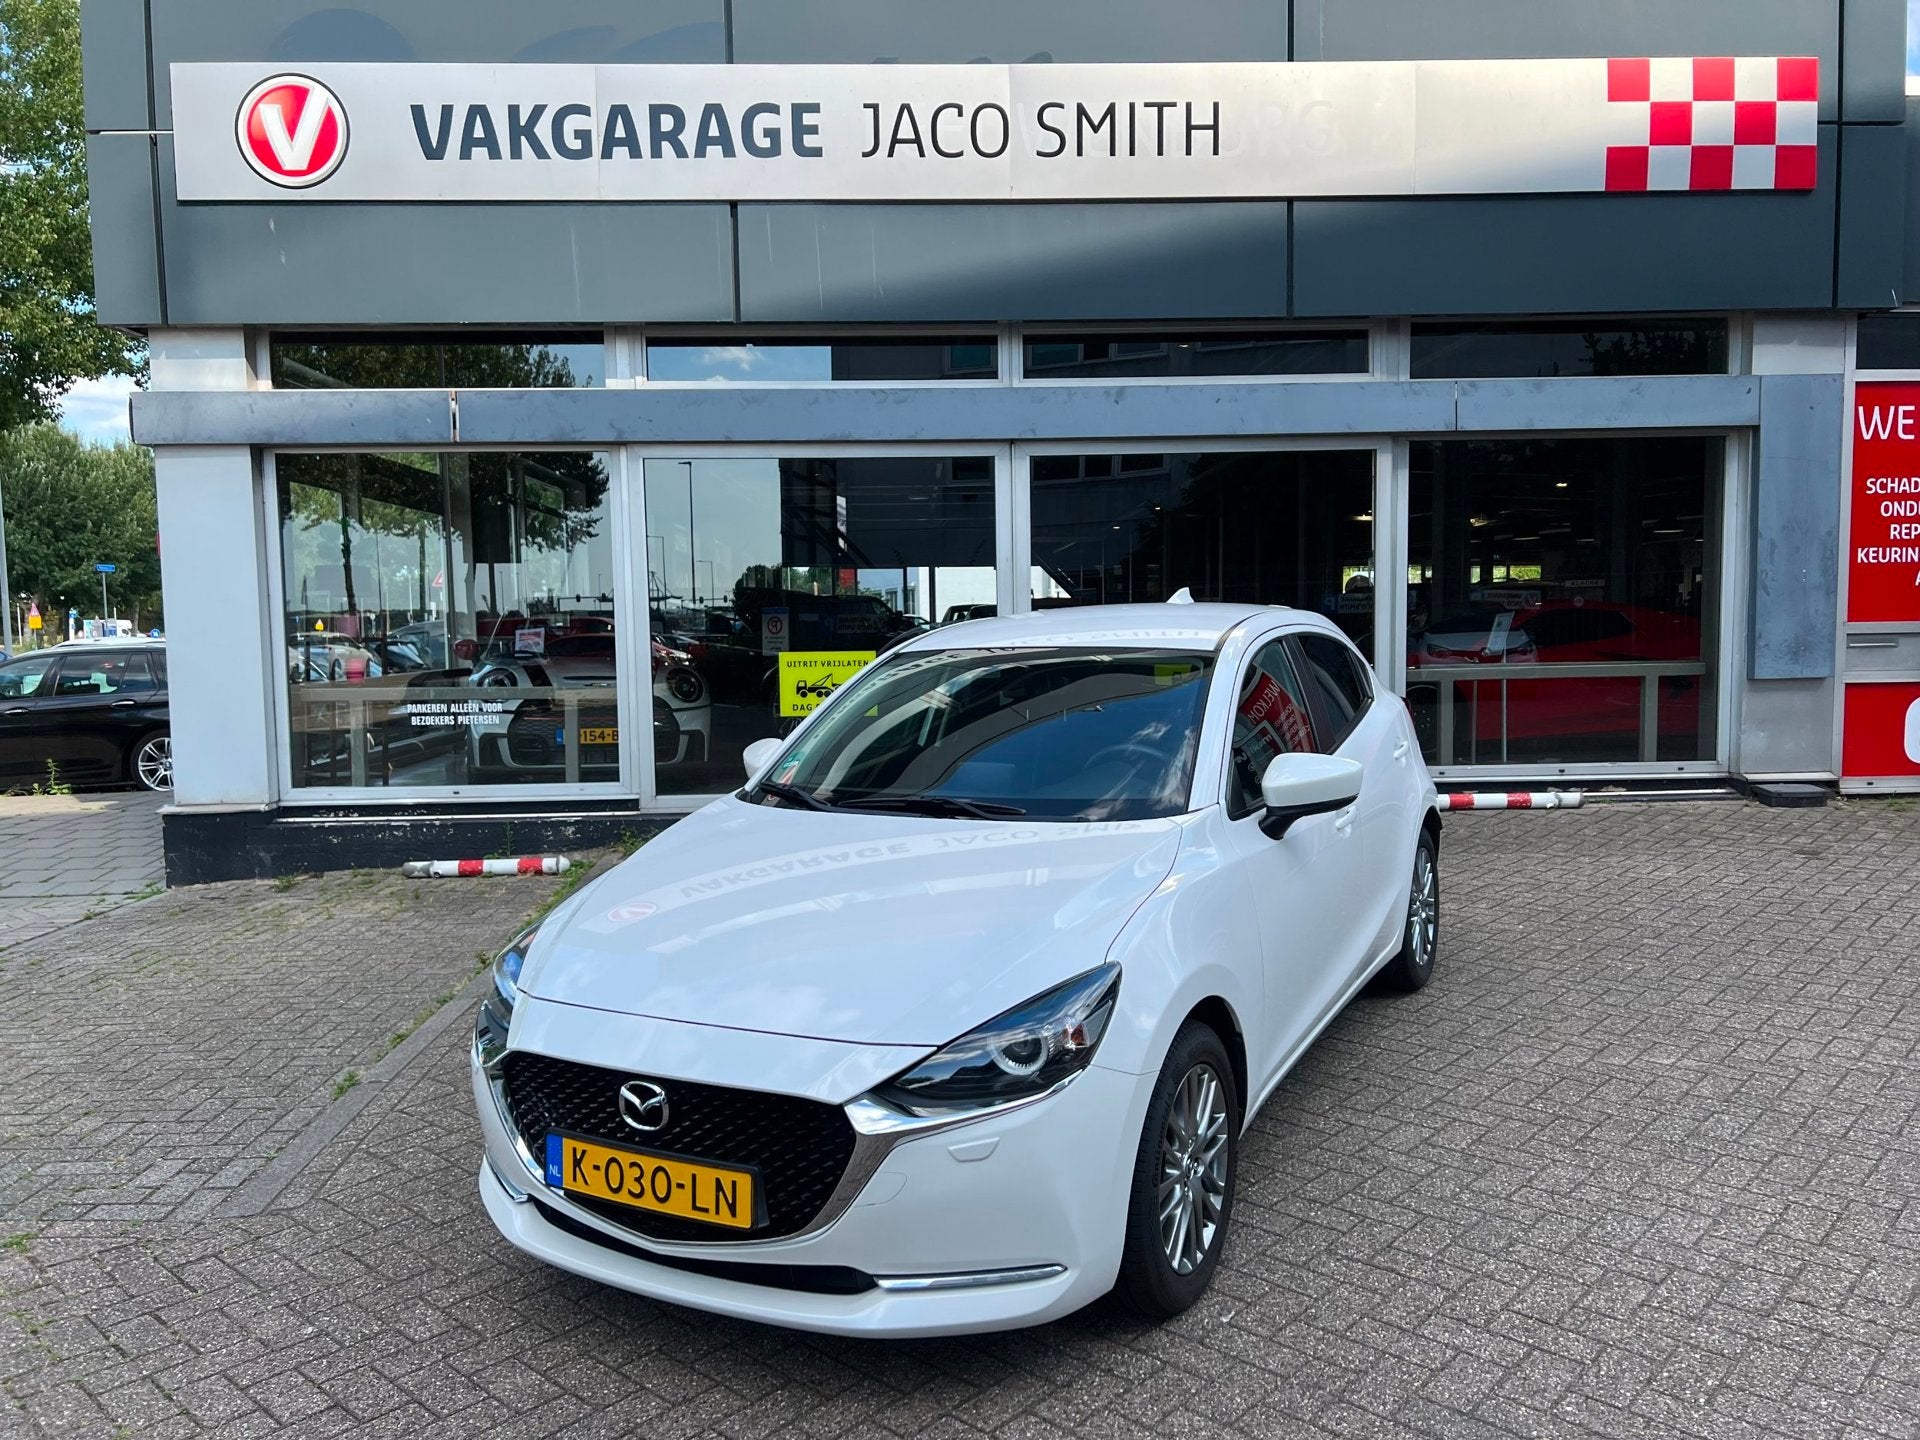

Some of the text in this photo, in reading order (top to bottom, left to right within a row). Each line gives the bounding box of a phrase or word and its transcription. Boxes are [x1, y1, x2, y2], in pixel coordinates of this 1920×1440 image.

[410, 102, 823, 160] VAKGARAGE
[862, 102, 1009, 158] JACO
[1036, 101, 1220, 158] SMITH
[1880, 500, 1920, 517] OND
[407, 702, 503, 713] PARKEREN ALLEEN VOOR
[411, 714, 500, 726] BEZOEKERS PIETERSEN
[549, 1163, 562, 1178] NL
[572, 1146, 737, 1218] K-030-LN
